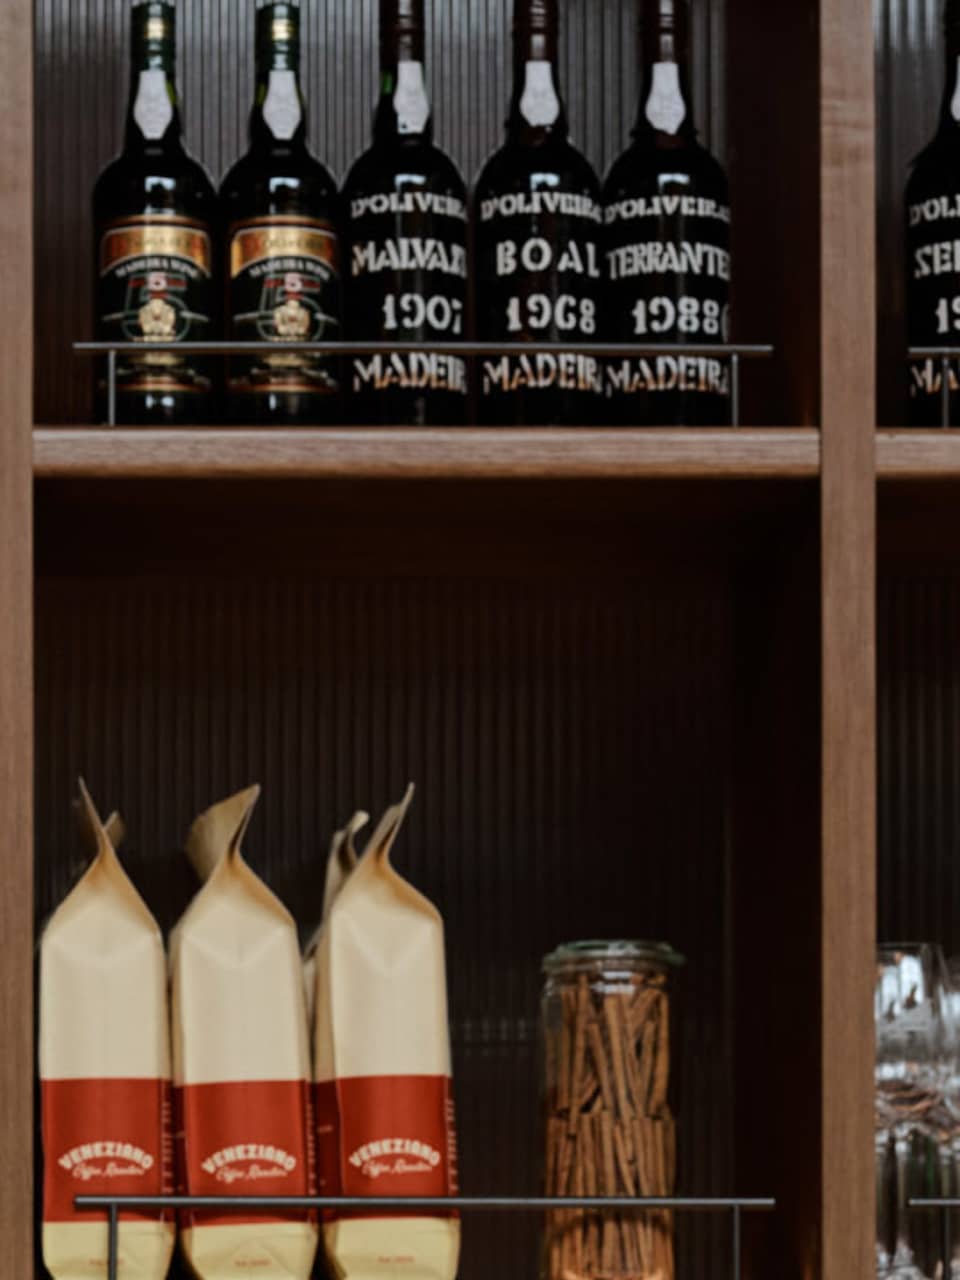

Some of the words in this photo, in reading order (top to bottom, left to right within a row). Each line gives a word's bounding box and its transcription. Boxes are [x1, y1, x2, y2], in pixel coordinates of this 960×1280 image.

[497, 237, 600, 277] BOAL
[147, 270, 168, 291] 5
[285, 271, 303, 293] 5
[506, 293, 596, 335] 1968
[632, 296, 719, 335] 1988
[483, 352, 602, 396] MADEIR
[58, 1141, 154, 1170] VENEZIANO
[201, 1143, 297, 1174] VENEZIANO
[348, 1138, 441, 1167] VENEZIANO
